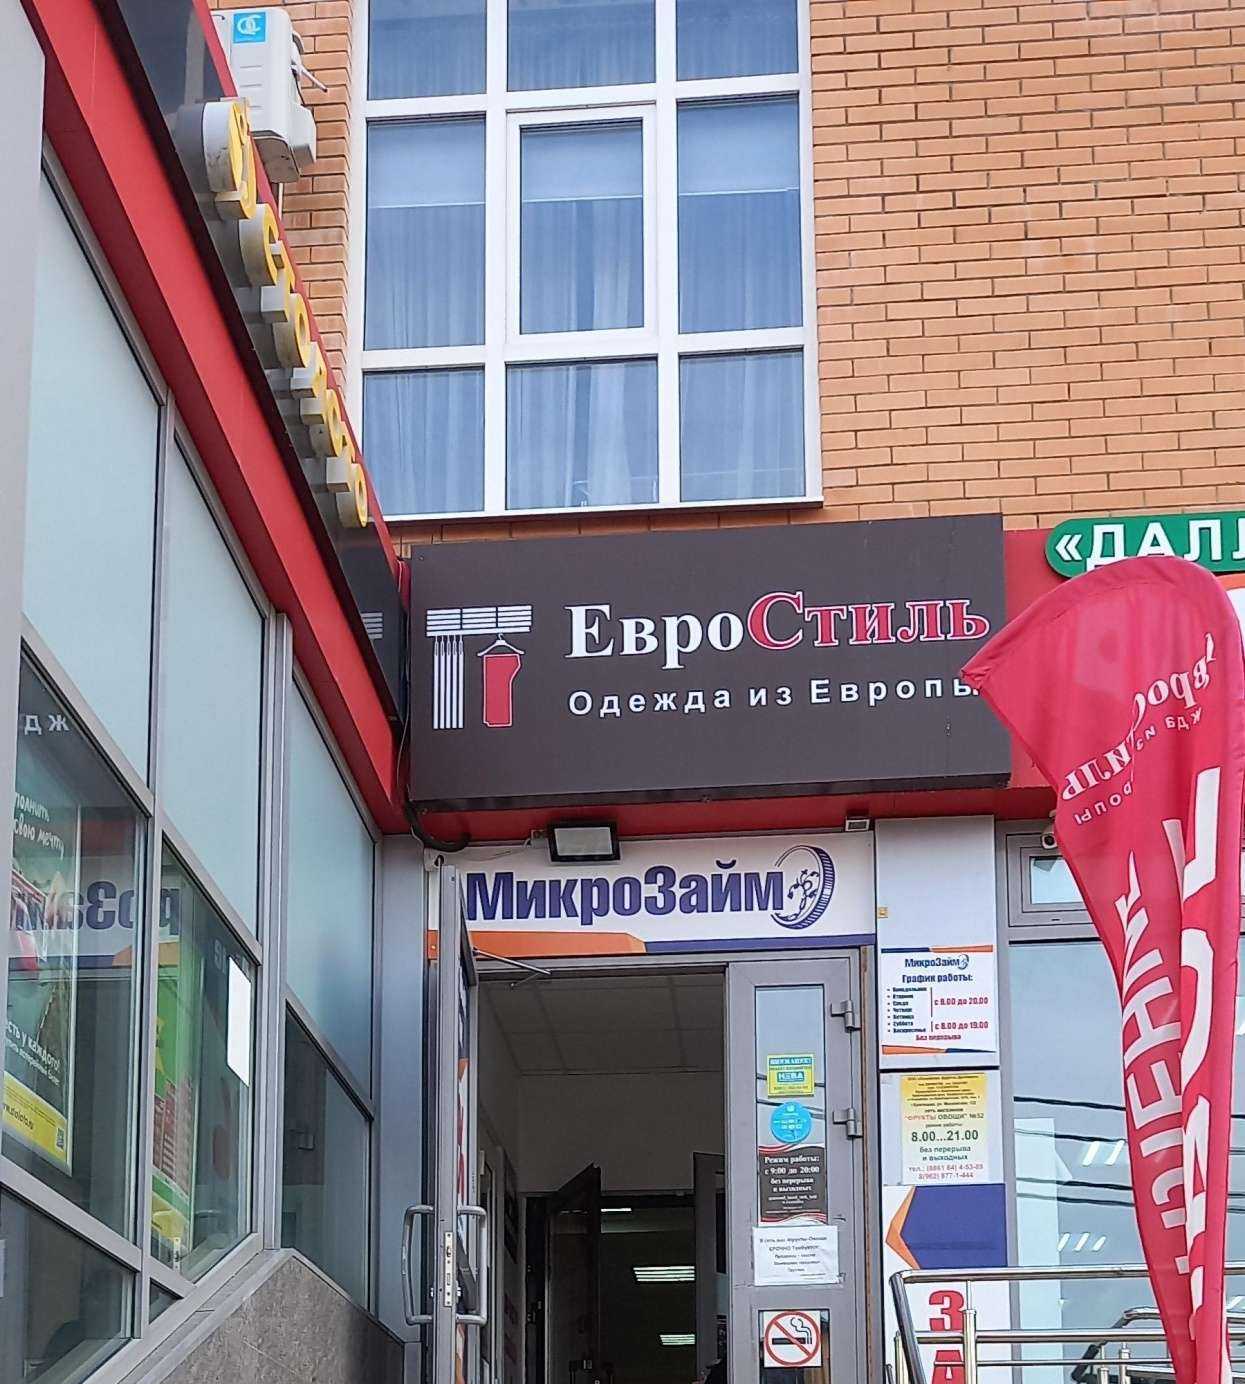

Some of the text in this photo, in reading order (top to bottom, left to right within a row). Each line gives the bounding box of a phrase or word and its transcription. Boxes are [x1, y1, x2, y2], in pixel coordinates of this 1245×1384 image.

[564, 591, 991, 673] ЕвроСтиль
[569, 676, 980, 718] Одежда из Европы
[467, 859, 784, 926] МикроЗайм
[904, 957, 960, 969] МикроЗайм
[902, 973, 974, 984] График работы:
[911, 1129, 979, 1142] 8.00...21.00
[933, 1146, 971, 1154] перерыва
[790, 1155, 820, 1164] работы:
[770, 1167, 787, 1175] 9:00
[799, 1166, 820, 1174] 20:00
